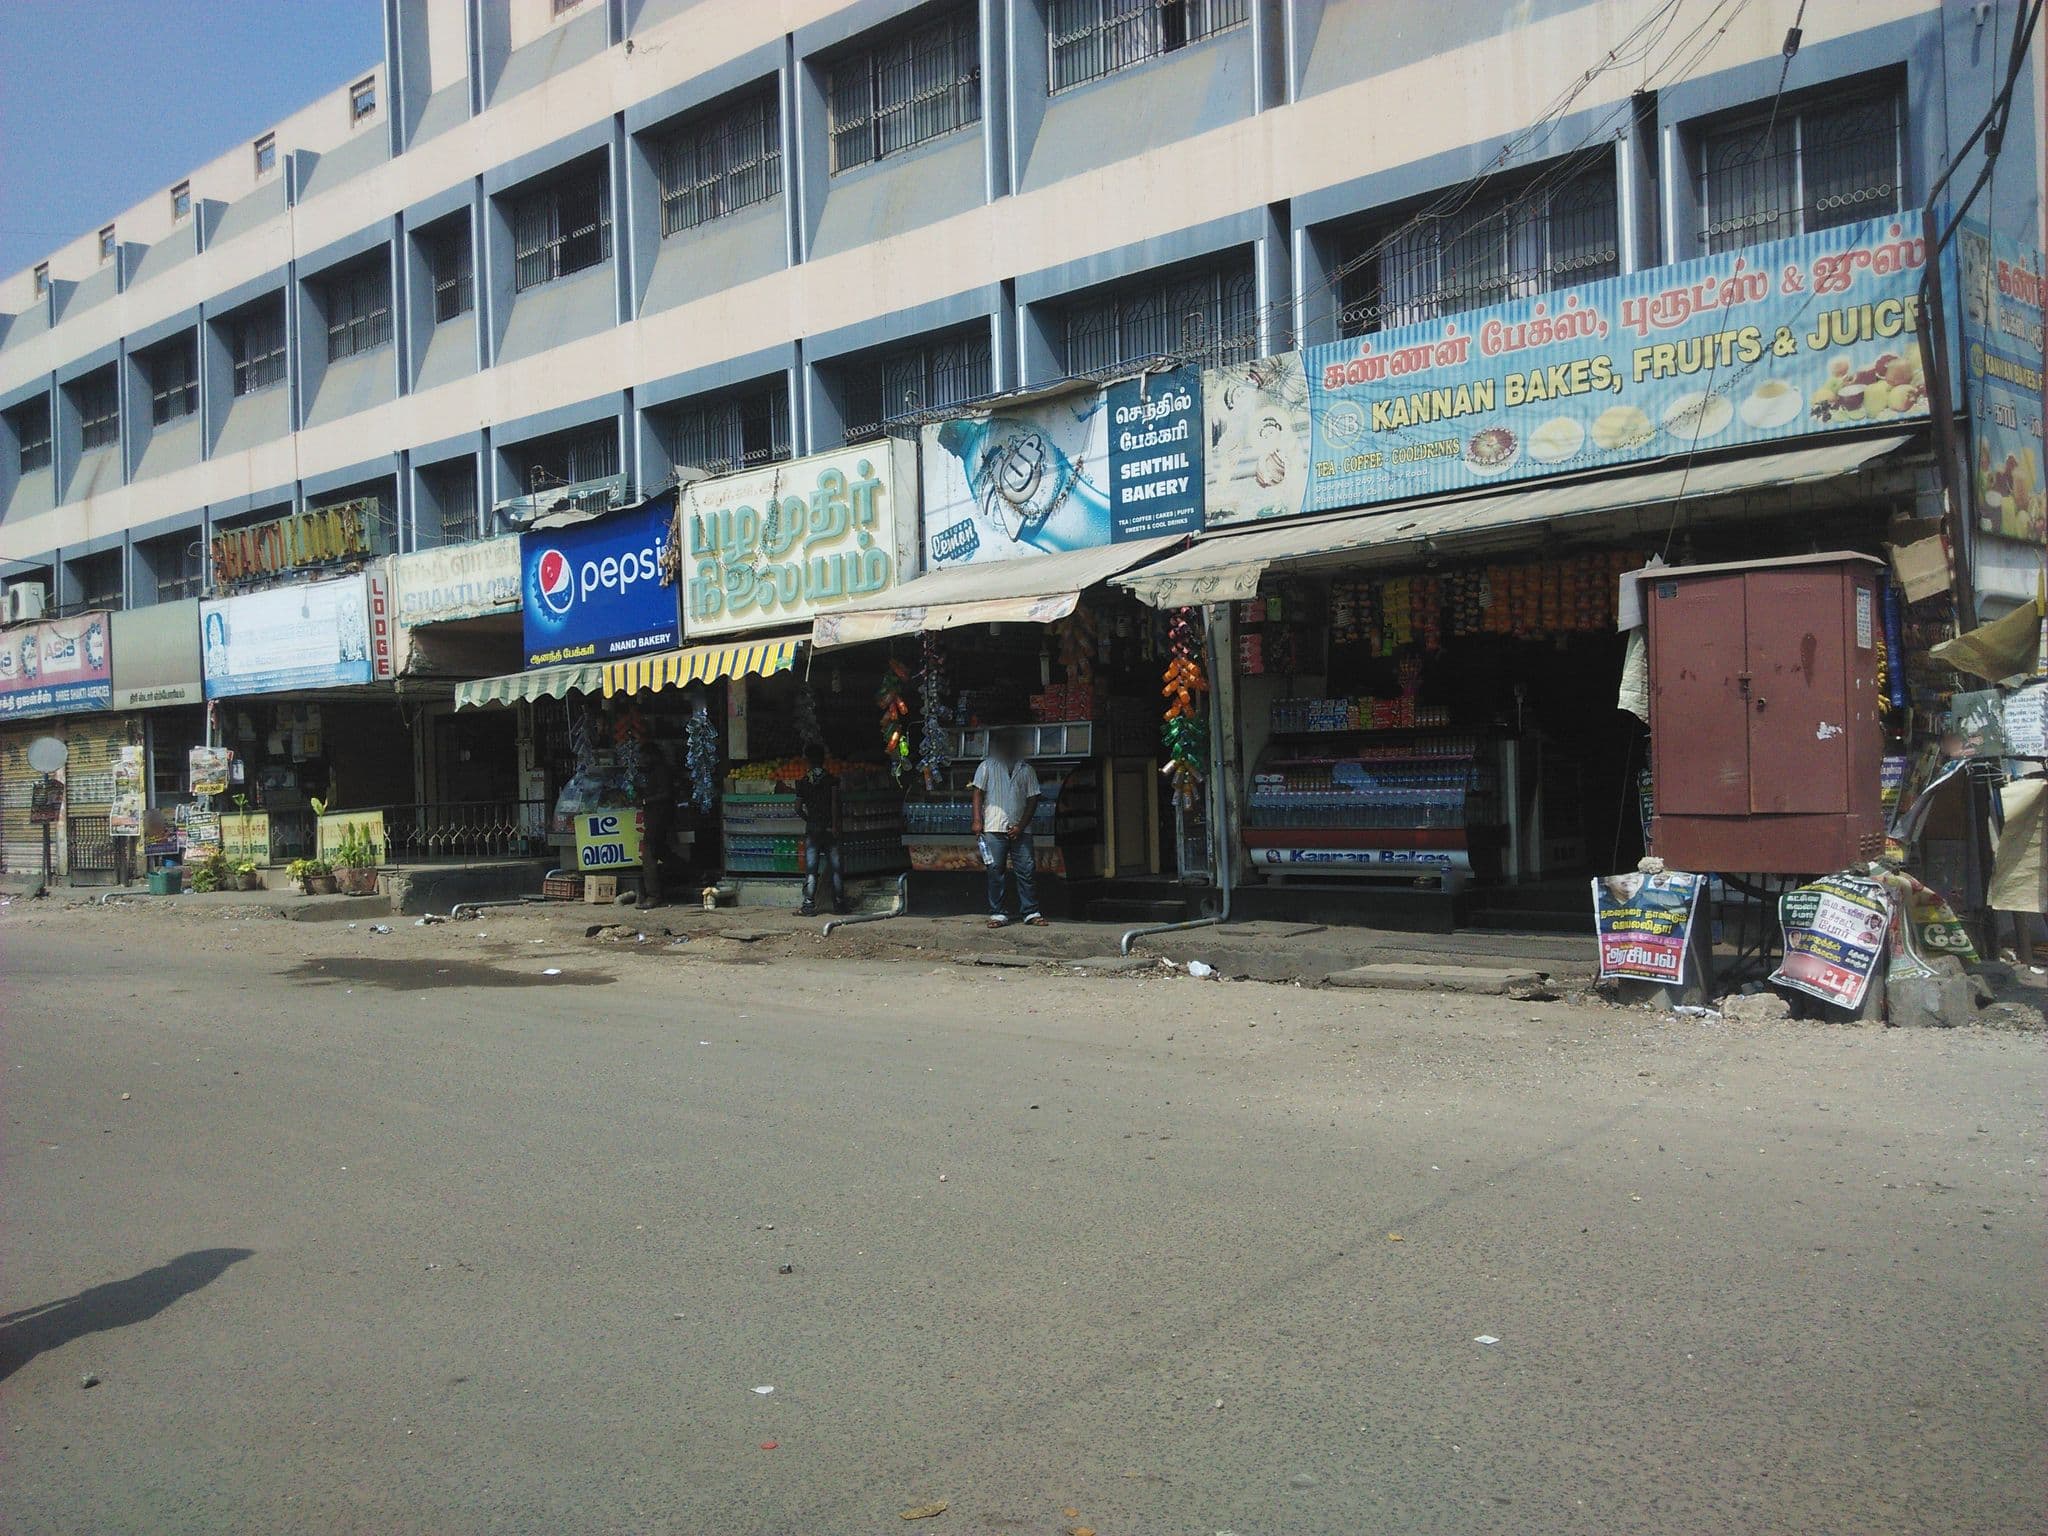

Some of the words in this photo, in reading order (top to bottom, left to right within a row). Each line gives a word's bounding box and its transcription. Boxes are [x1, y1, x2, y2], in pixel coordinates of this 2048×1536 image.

[1323, 324, 1471, 390] கண்ணன்
[1781, 265, 1805, 295] &
[1371, 378, 1496, 433] KANNAN
[1504, 355, 1623, 408] BAKES,
[1632, 326, 1763, 383] FRUITS
[1772, 326, 1798, 359] &
[1115, 387, 1192, 424] செந்தில்
[1120, 419, 1189, 451] பேக்கரி
[1121, 453, 1189, 480] SENTHIL
[1316, 458, 1336, 477] TEA
[1342, 452, 1383, 474] COFFEE
[1391, 438, 1461, 465] COOLDRINKS
[1122, 477, 1189, 503] BAKERY
[688, 458, 883, 564] பழமுதிர்
[1119, 518, 1129, 526] TEA
[1132, 513, 1152, 524] COFFEE
[1155, 511, 1173, 520] CAKES
[1177, 508, 1194, 517] PUFFS
[1125, 525, 1146, 534] SWEETS
[1167, 518, 1188, 527] DRINKS
[932, 526, 975, 559] lemon
[580, 537, 664, 602] pepsi
[688, 532, 890, 617] நிலையம்
[372, 578, 390, 675] LODGE
[609, 639, 637, 652] ANAND
[638, 633, 671, 648] BAKERY
[589, 816, 620, 836] டீ
[582, 843, 633, 866] வடை
[1379, 850, 1451, 865] Bakes
